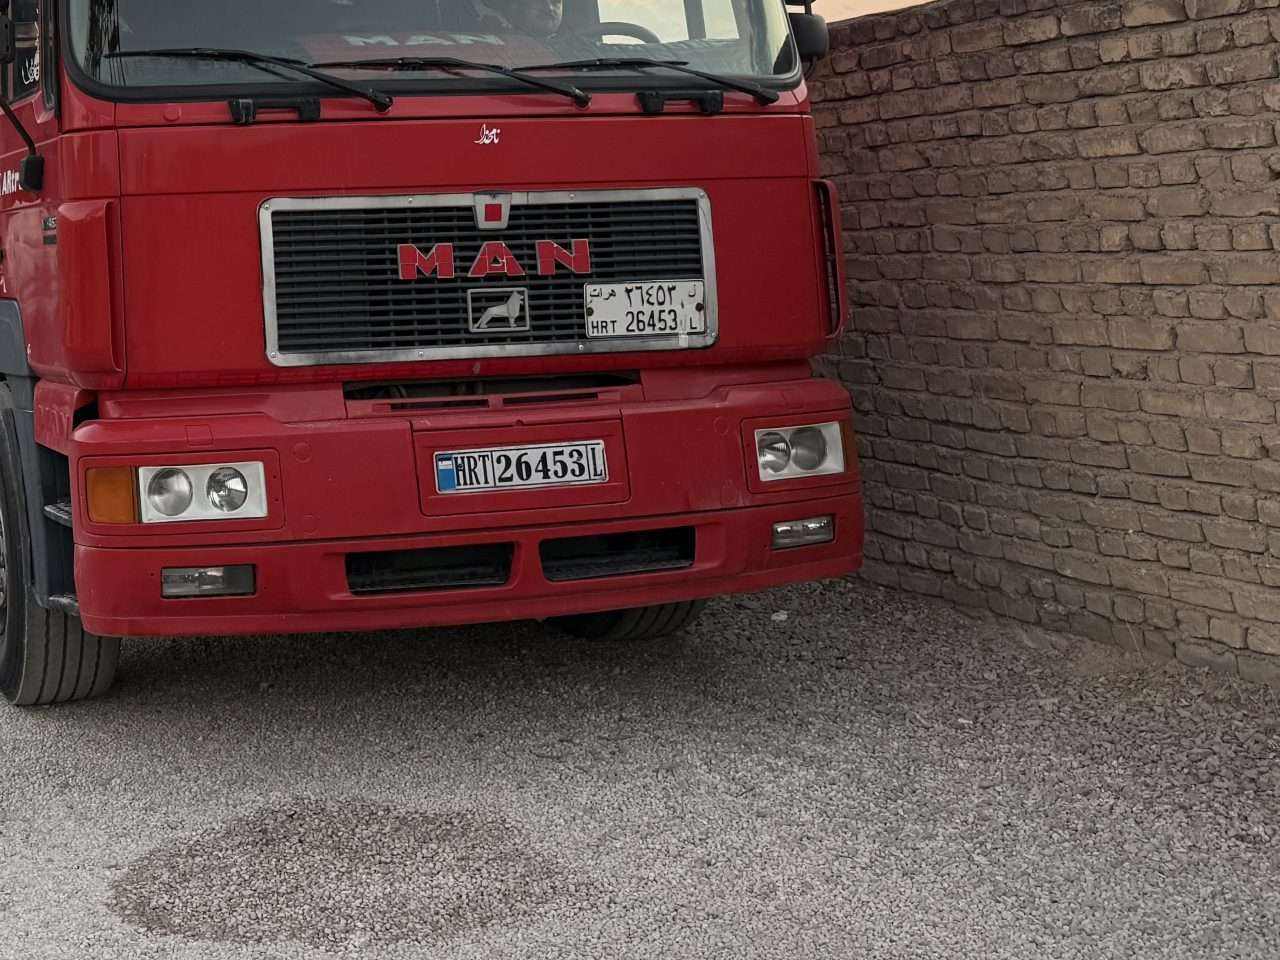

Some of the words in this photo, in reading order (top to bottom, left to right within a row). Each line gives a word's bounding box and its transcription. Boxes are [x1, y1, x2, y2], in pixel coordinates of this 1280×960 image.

[397, 238, 591, 280] MAN
[589, 287, 617, 301] هرات
[591, 319, 617, 334] HRT
[625, 309, 678, 333] 26453
[689, 316, 697, 330] L
[454, 453, 490, 487] HRT
[496, 448, 586, 483] 26453
[590, 447, 603, 477] L
